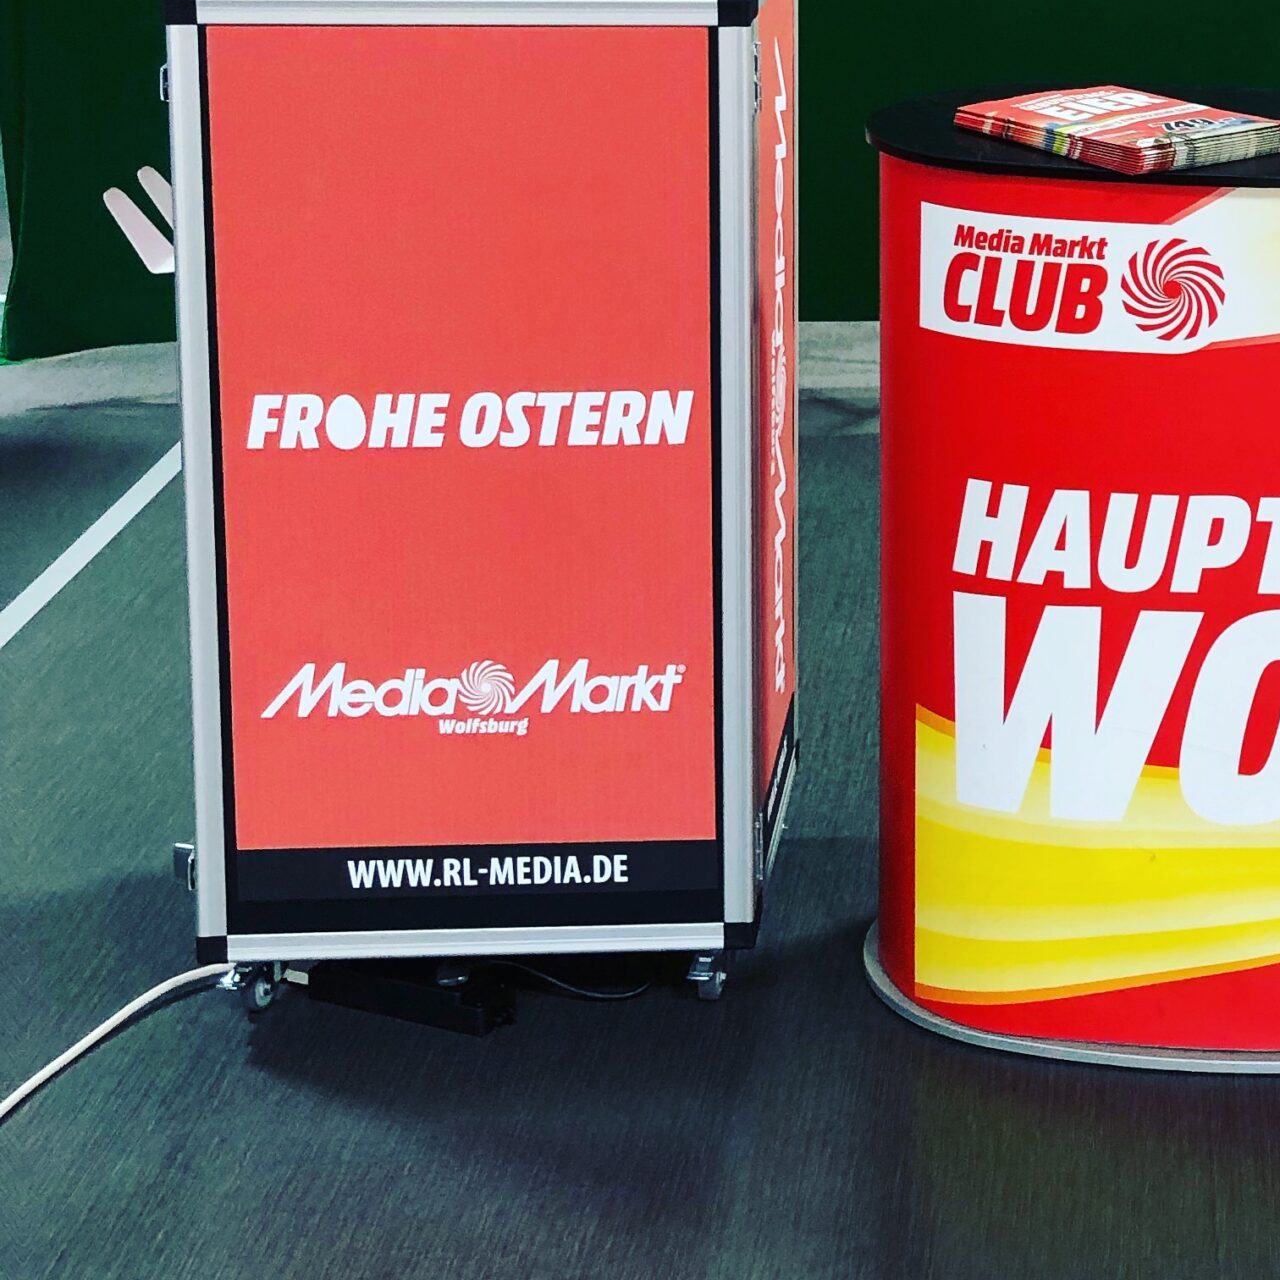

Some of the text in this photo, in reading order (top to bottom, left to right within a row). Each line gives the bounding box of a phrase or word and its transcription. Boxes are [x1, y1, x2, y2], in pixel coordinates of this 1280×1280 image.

[1046, 89, 1169, 121] EIER
[954, 224, 1108, 262] Media Markt
[942, 252, 1108, 334] CLUB
[459, 390, 694, 448] OSTERN
[261, 658, 684, 718] Media Markt
[439, 717, 529, 736] Wolfsburg
[348, 855, 629, 889] WWW.RL-MEDIA.DE
